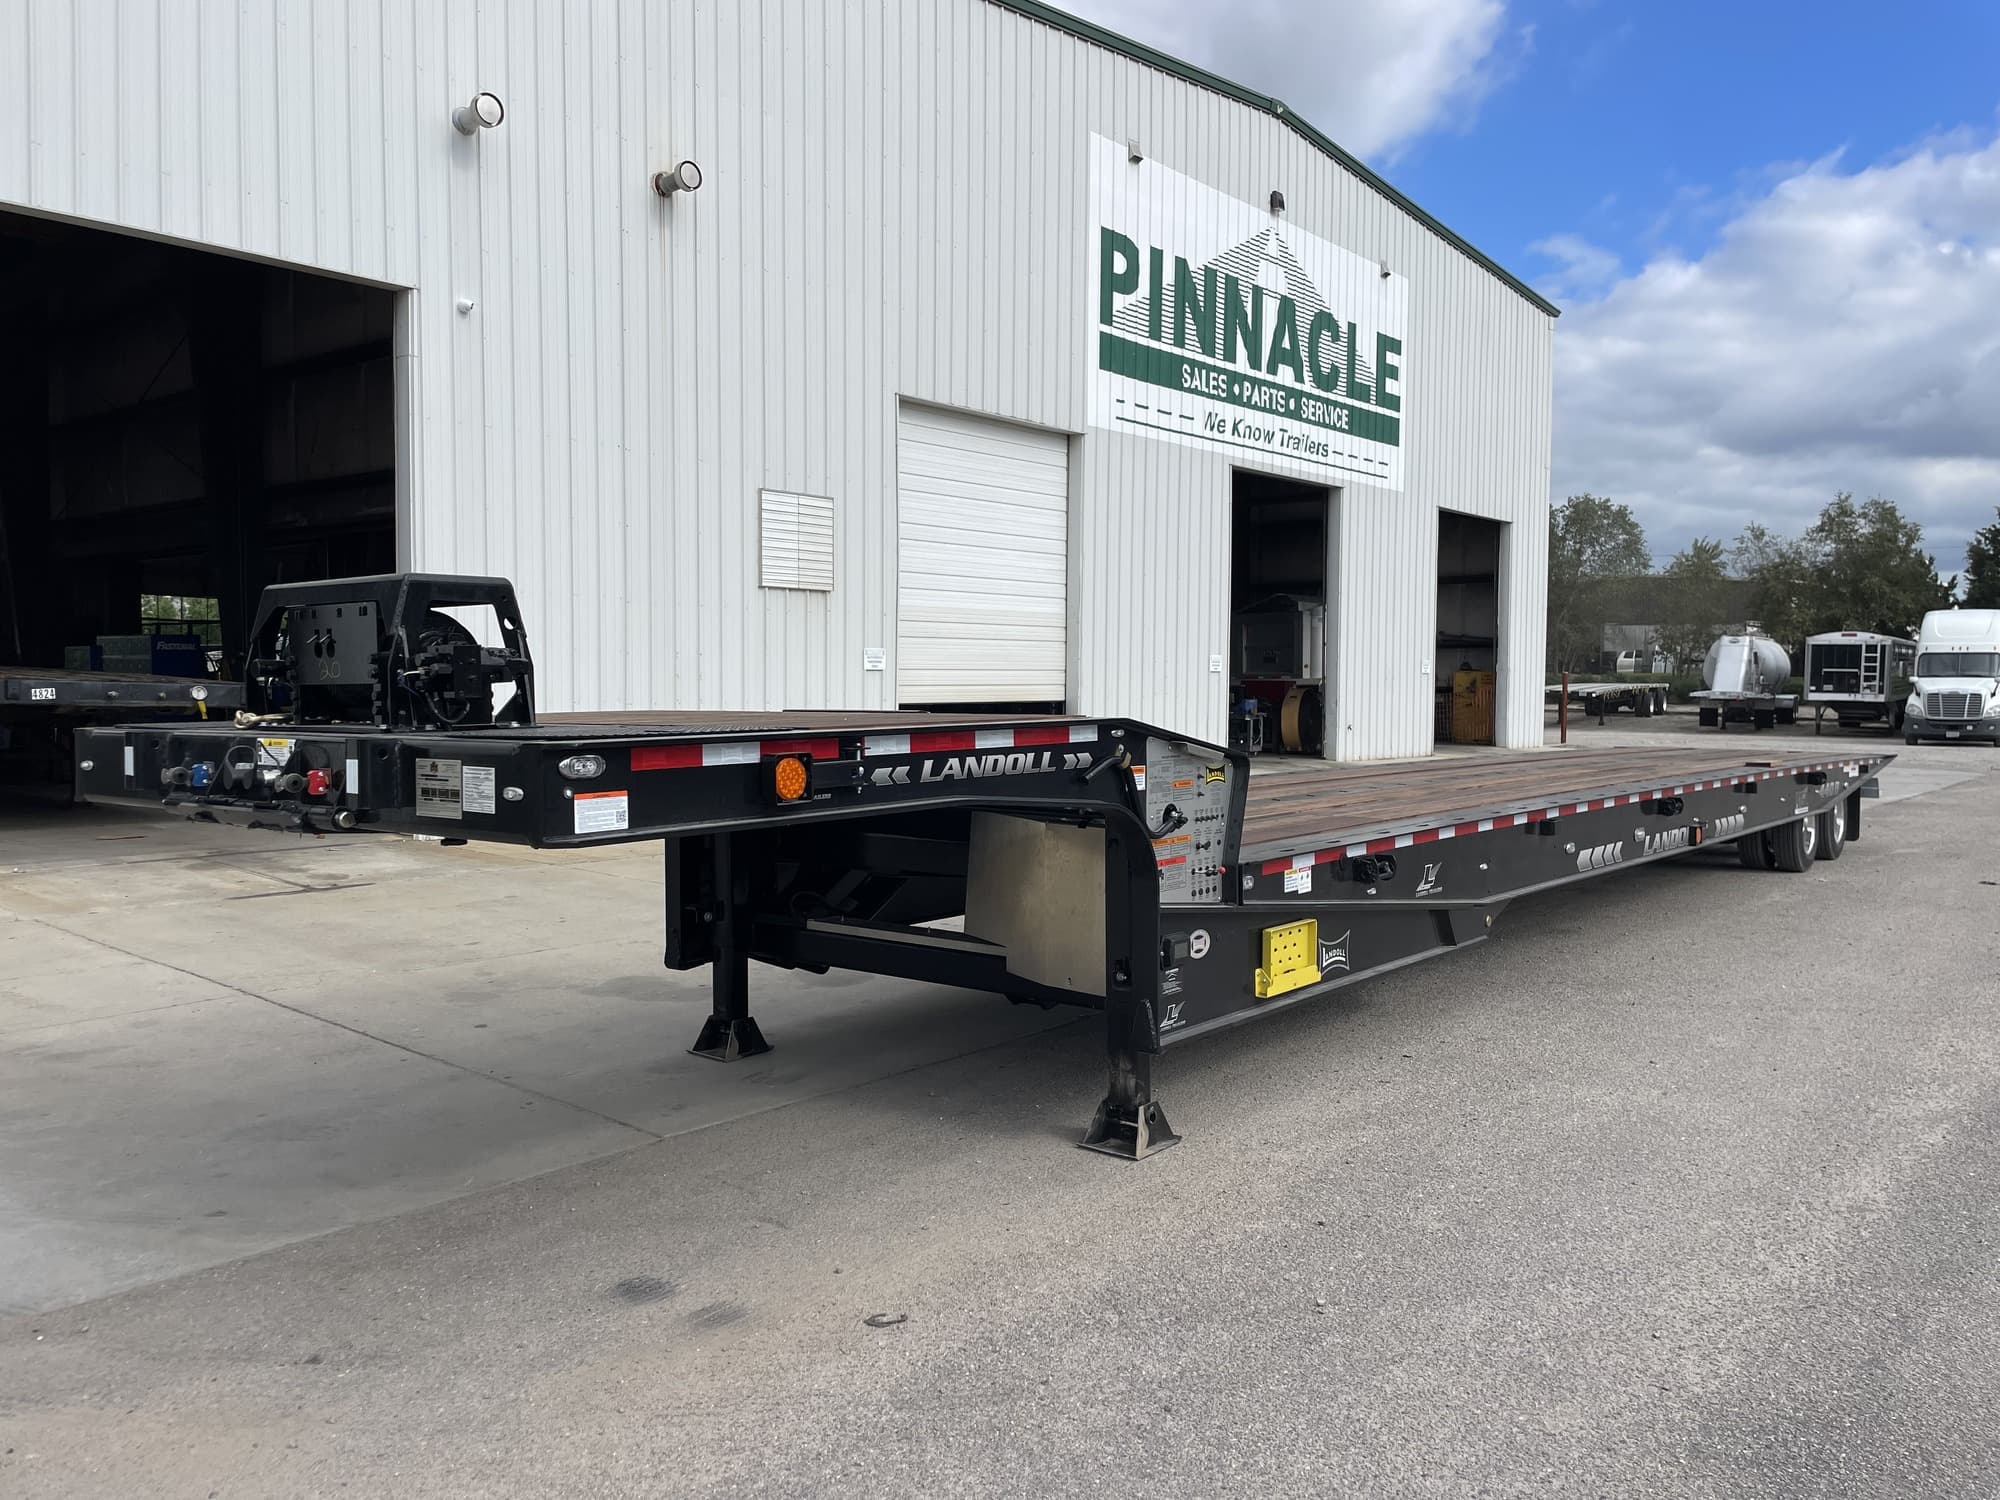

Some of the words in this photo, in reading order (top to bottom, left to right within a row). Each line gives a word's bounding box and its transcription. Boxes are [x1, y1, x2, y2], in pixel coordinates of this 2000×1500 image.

[1100, 225, 1402, 413] PINNACLE
[1182, 363, 1227, 397] SALES
[1243, 381, 1285, 412] PARTS
[1301, 397, 1349, 430] SERVICE
[1202, 411, 1226, 433] We
[1231, 416, 1275, 444] Know
[1279, 428, 1329, 457] Trailers
[32, 688, 56, 699] 4824
[920, 752, 1056, 783] LANDOLL
[1643, 826, 1690, 856] LANDO
